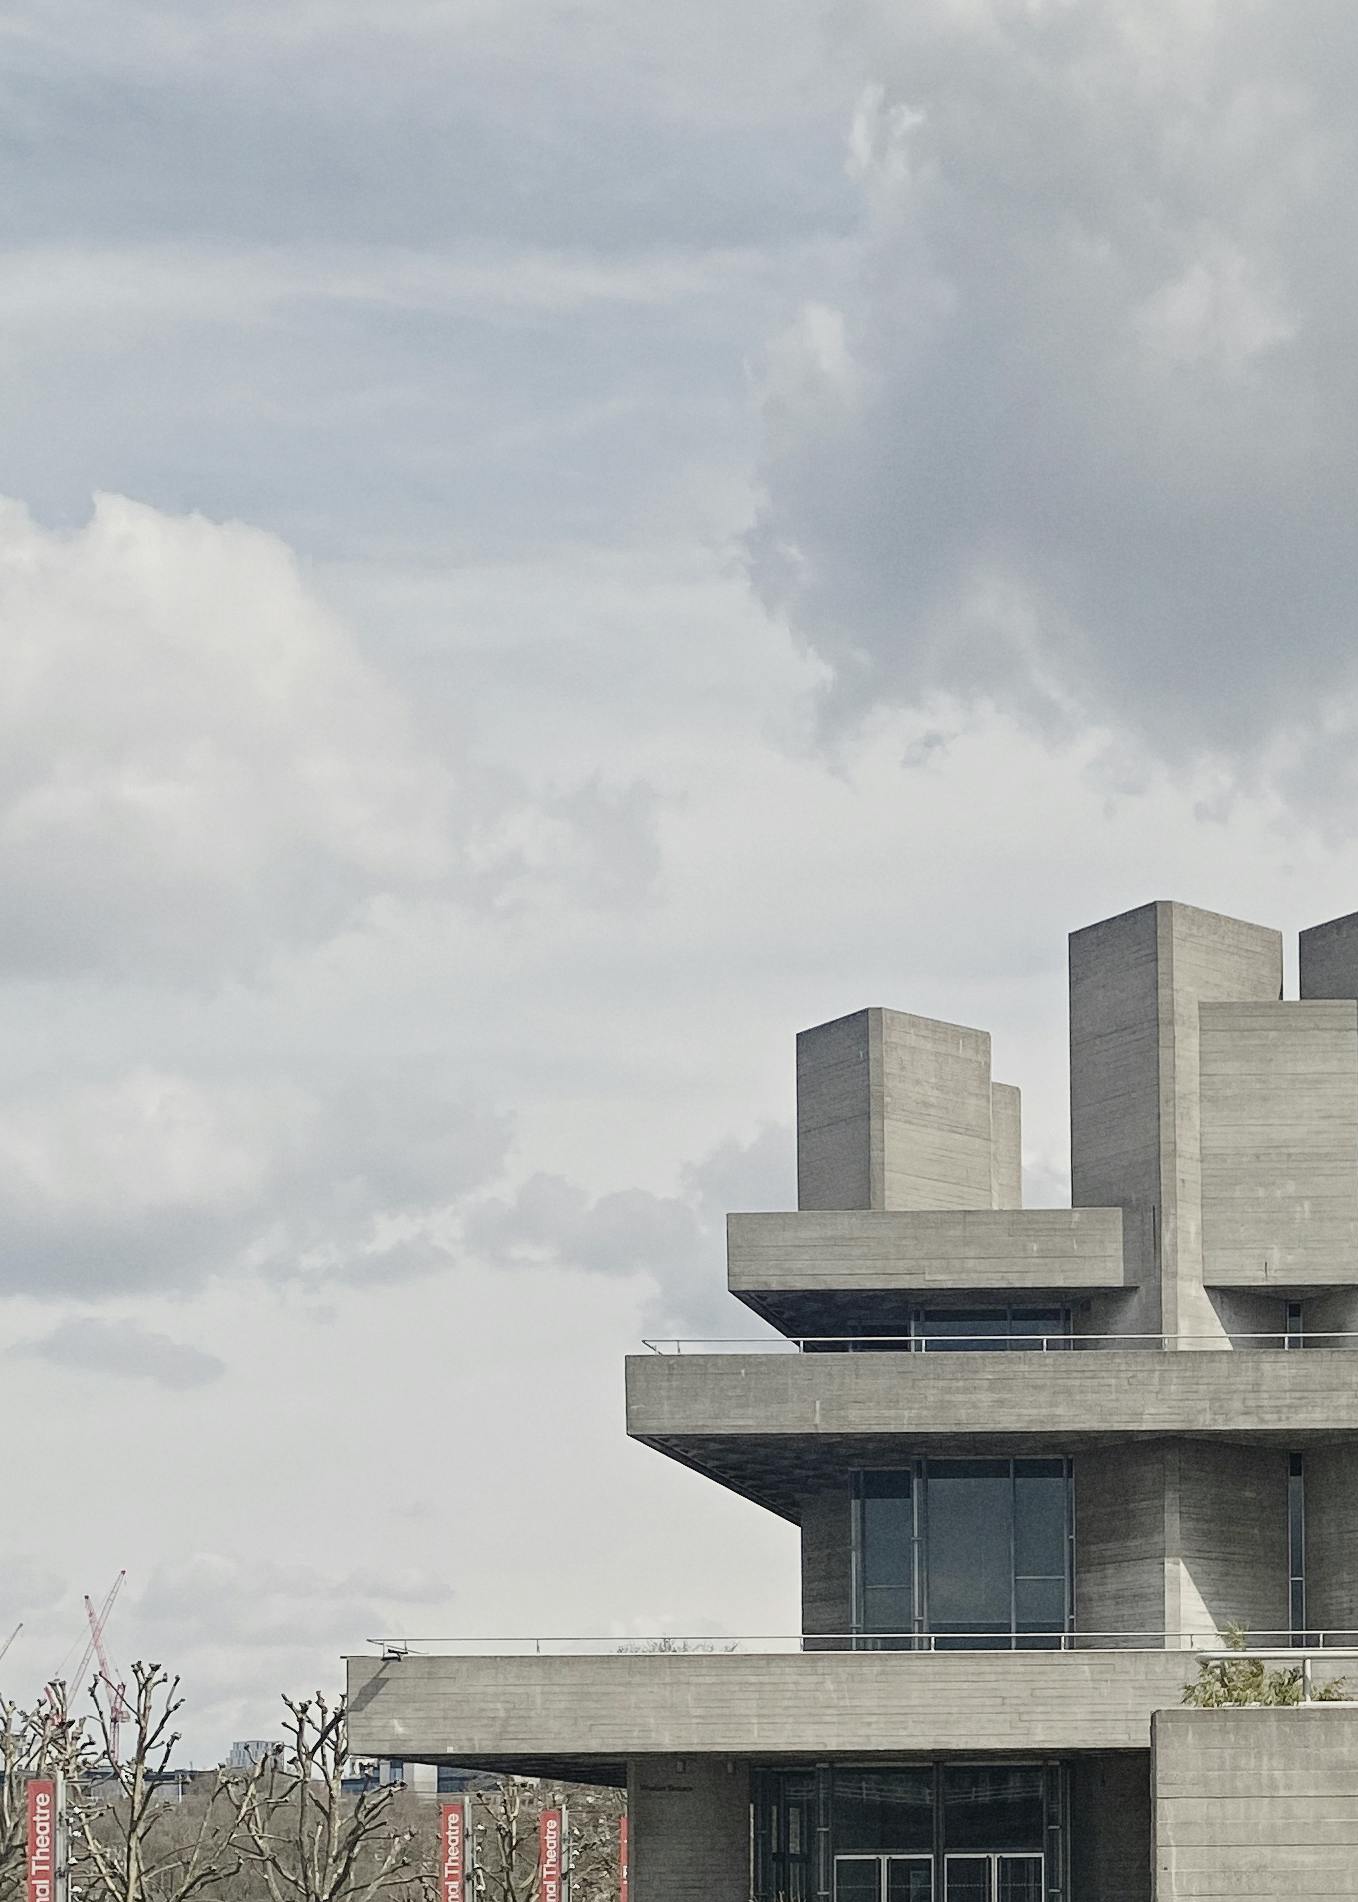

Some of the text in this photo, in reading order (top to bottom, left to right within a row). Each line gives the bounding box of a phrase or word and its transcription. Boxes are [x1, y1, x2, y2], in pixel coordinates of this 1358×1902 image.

[31, 1793, 50, 1876] Theatre
[444, 1813, 459, 1878] Theatre
[543, 1819, 557, 1878] Theatre
